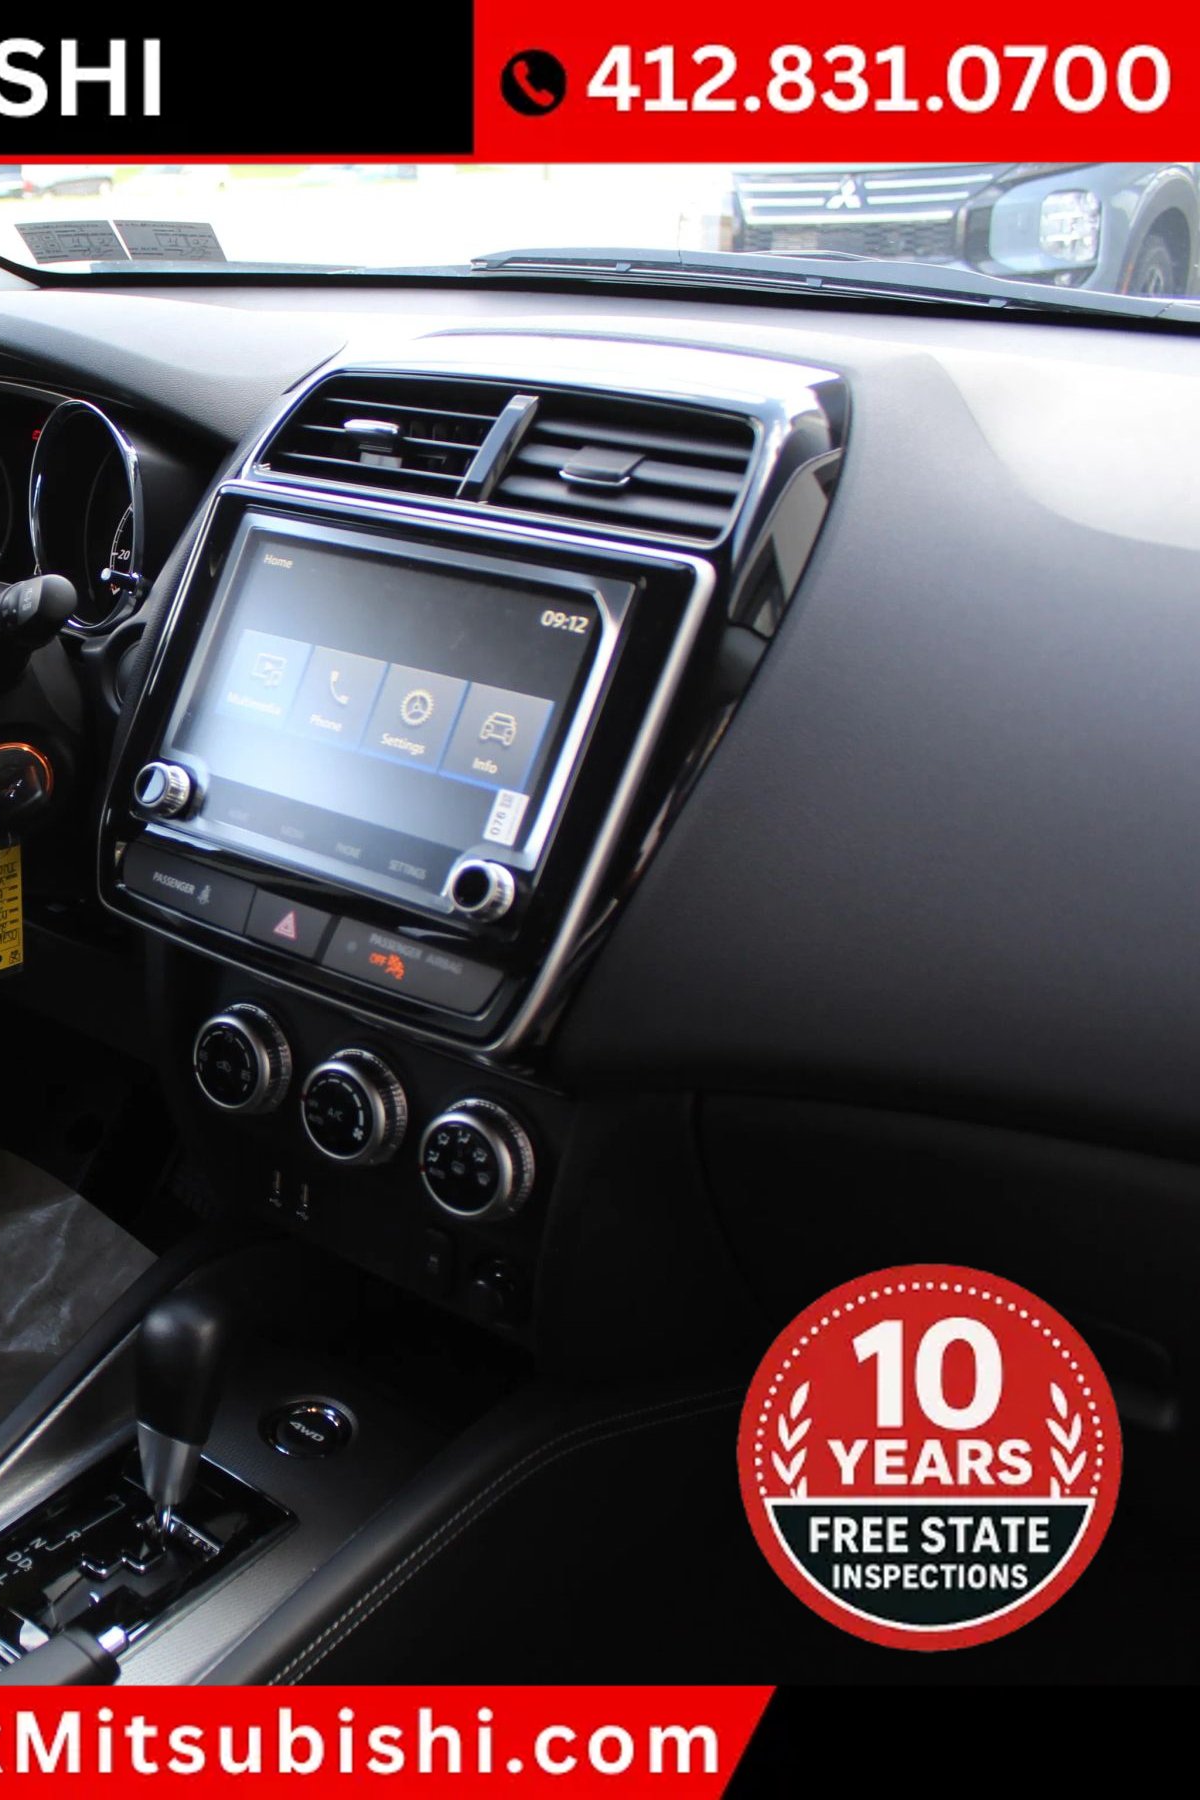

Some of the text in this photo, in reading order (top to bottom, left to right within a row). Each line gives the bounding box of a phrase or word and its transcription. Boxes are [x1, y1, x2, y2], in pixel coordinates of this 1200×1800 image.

[117, 549, 131, 561] 20
[263, 553, 293, 570] Home
[541, 610, 590, 634] 09:12
[309, 713, 343, 733] Phone
[380, 732, 426, 756] Settings
[472, 757, 499, 774] Info
[152, 871, 195, 896] PASSENGER
[368, 933, 464, 976] PASSENGER AIRBAG
[368, 951, 388, 967] OFF
[290, 1421, 325, 1442] 4WD
[29, 1537, 48, 1550] N
[65, 1530, 81, 1542] R
[6, 1551, 22, 1563] D
